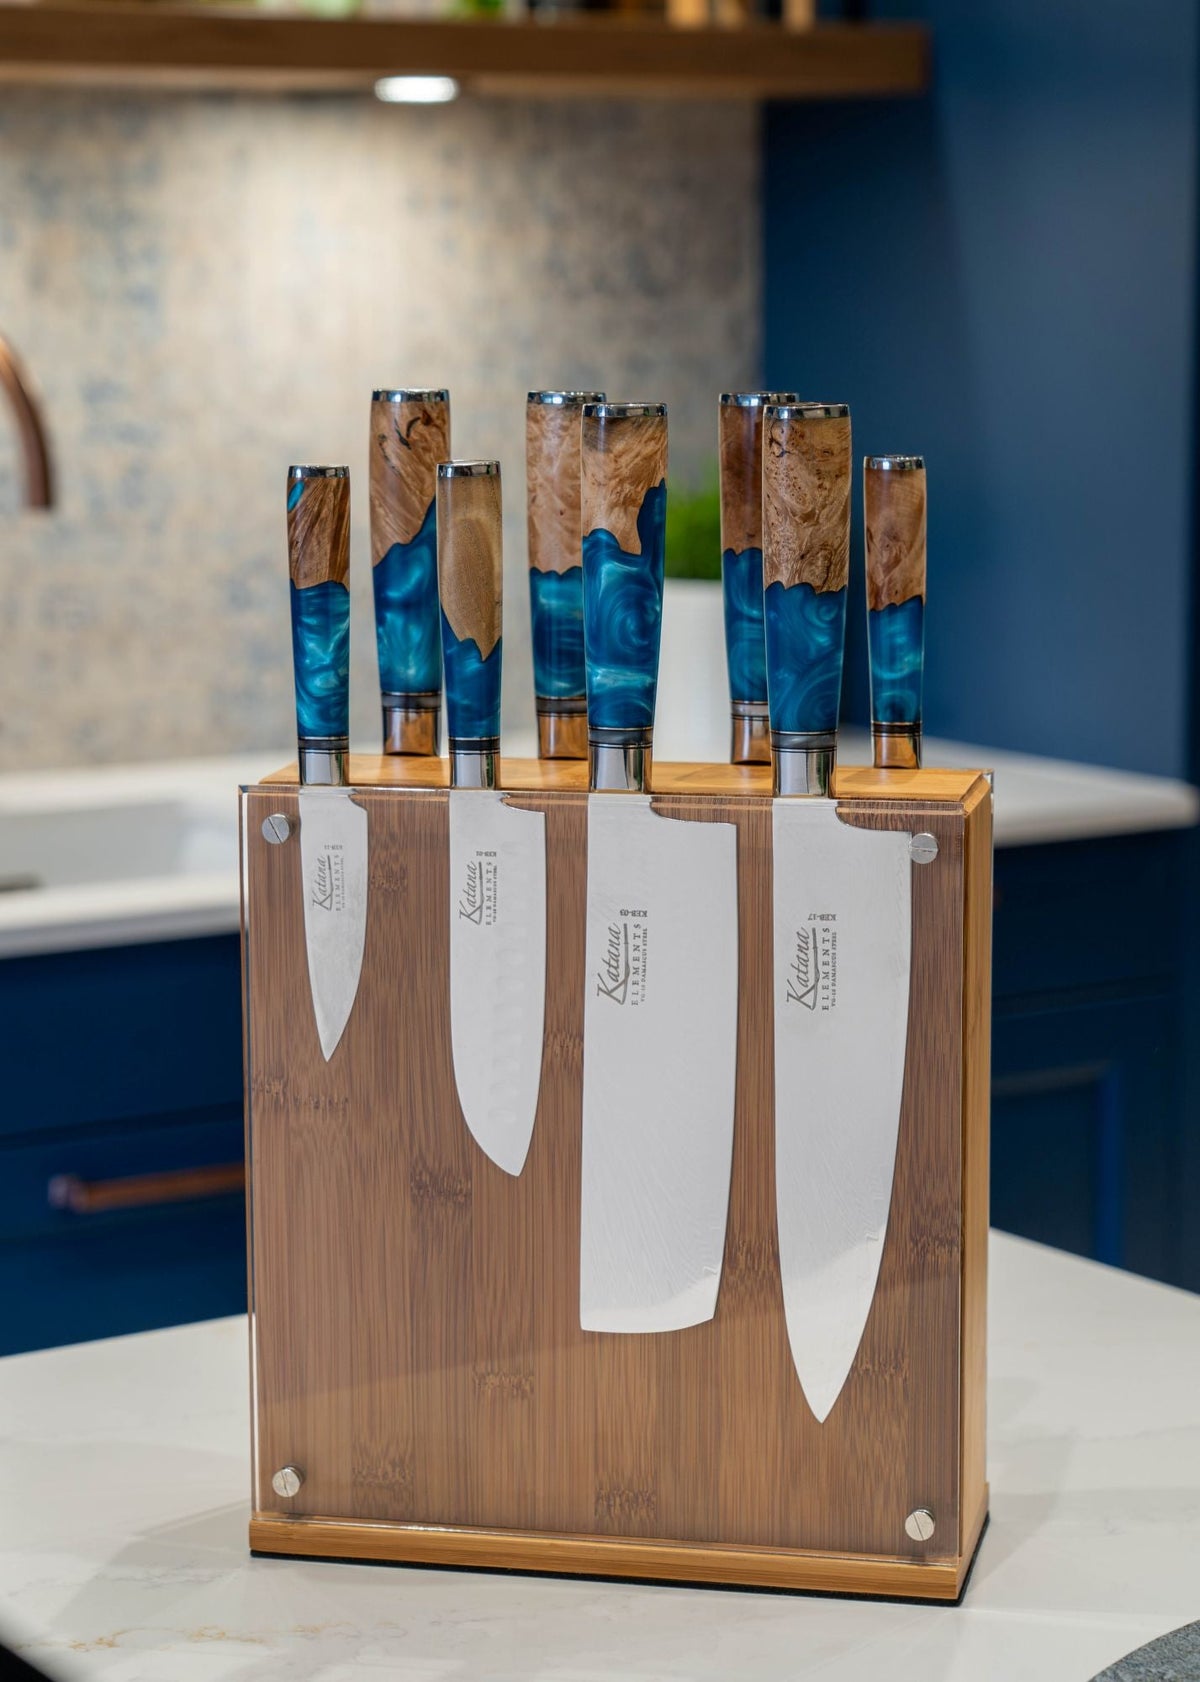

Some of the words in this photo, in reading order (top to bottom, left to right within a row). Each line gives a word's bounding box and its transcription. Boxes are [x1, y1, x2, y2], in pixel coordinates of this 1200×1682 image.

[312, 855, 332, 911] Katana
[459, 861, 483, 926] Katana
[808, 913, 836, 921] KEB-17
[596, 922, 629, 1006] Katana
[631, 923, 641, 1006] ELEMENTS
[786, 926, 820, 1011] Katana
[822, 927, 830, 1011] ELEMENTS
